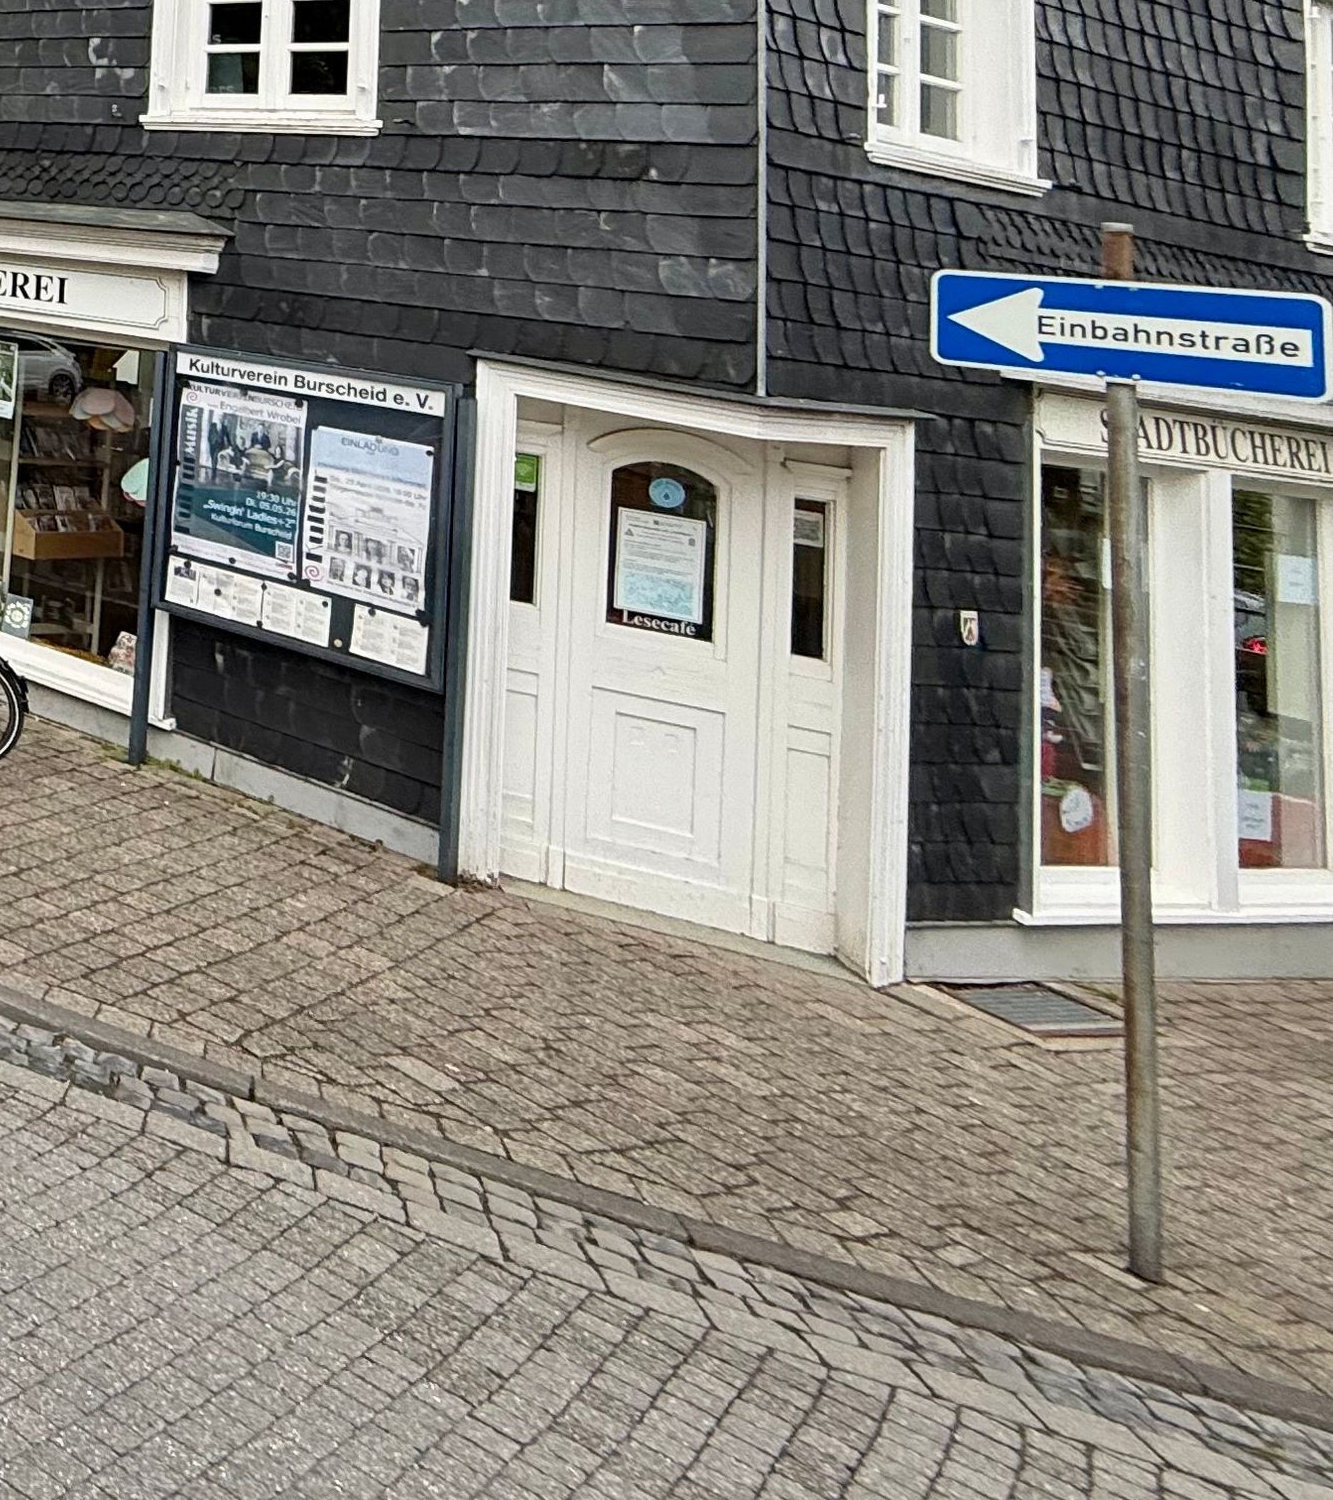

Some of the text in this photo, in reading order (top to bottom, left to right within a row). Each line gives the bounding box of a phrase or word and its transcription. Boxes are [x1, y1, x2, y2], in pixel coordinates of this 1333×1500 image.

[1038, 314, 1301, 359] Einbahnstraße
[189, 358, 434, 410] Kulturverein Burscheid e. V.
[622, 609, 697, 636] Lesecafé
